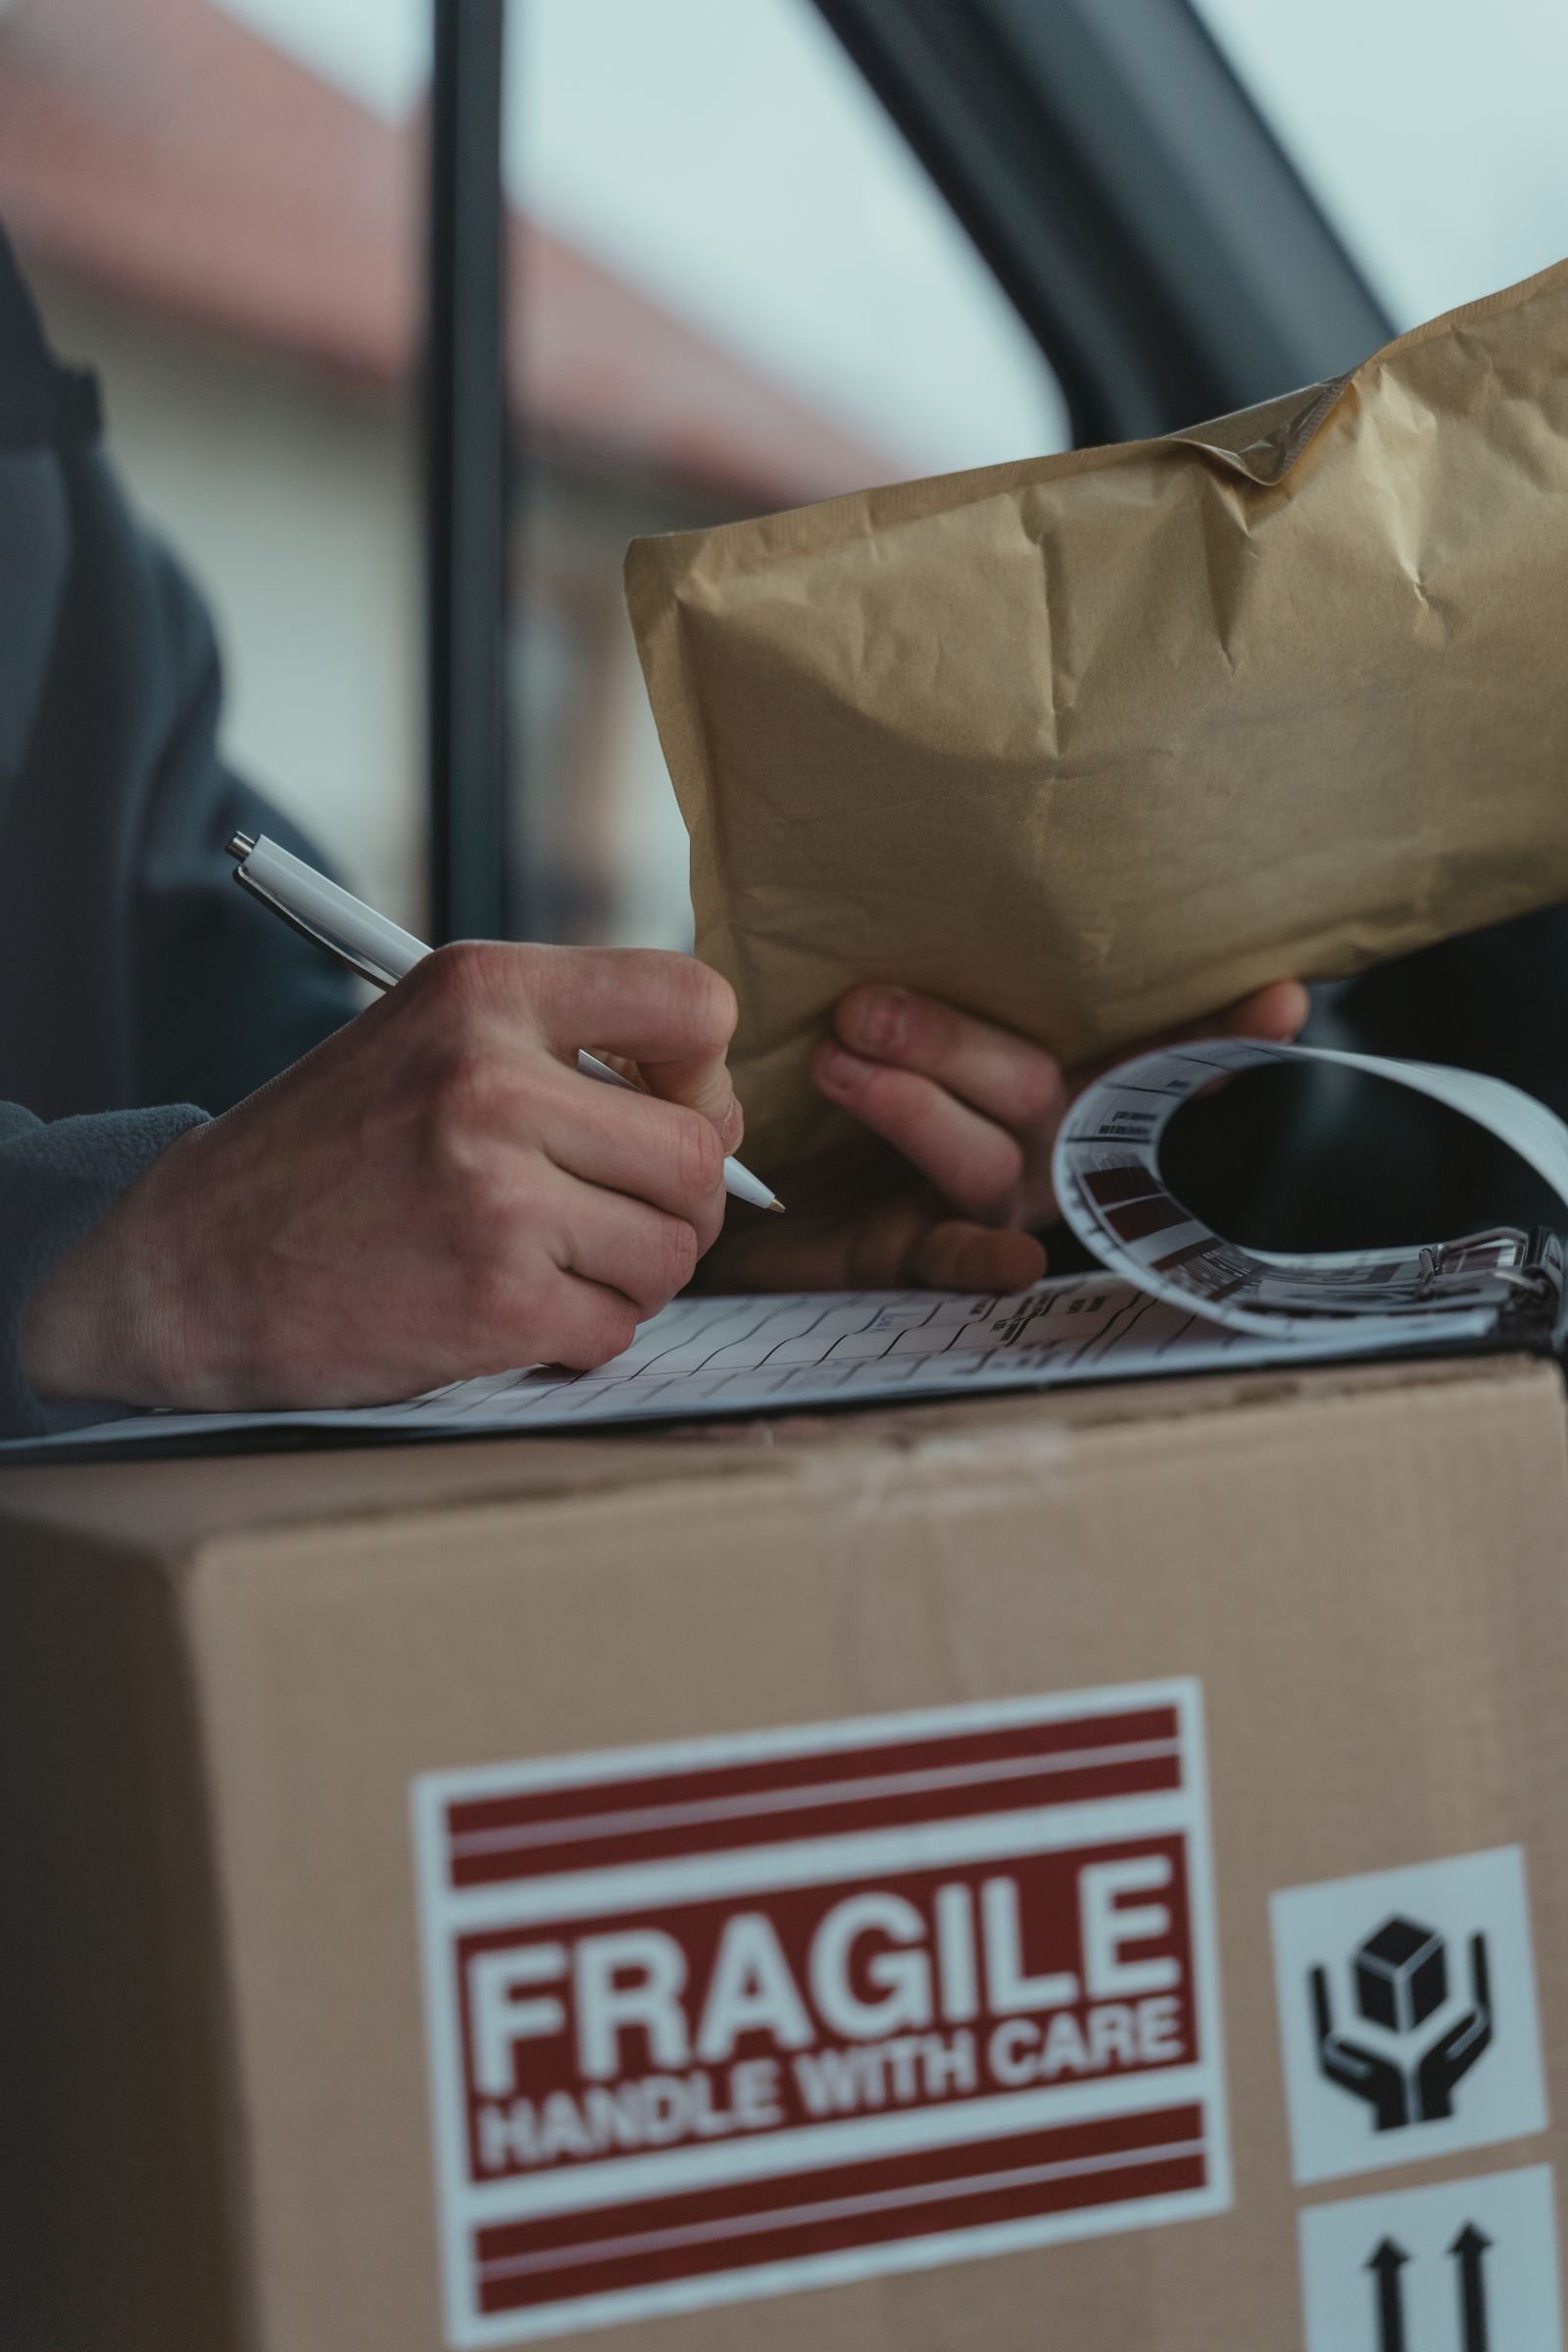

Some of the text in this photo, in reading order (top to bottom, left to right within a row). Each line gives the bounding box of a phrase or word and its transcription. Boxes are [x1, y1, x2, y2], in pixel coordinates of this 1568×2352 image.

[467, 1854, 1180, 2095] FRAGILE
[480, 1997, 1182, 2169] HANDLE WITH CARE
